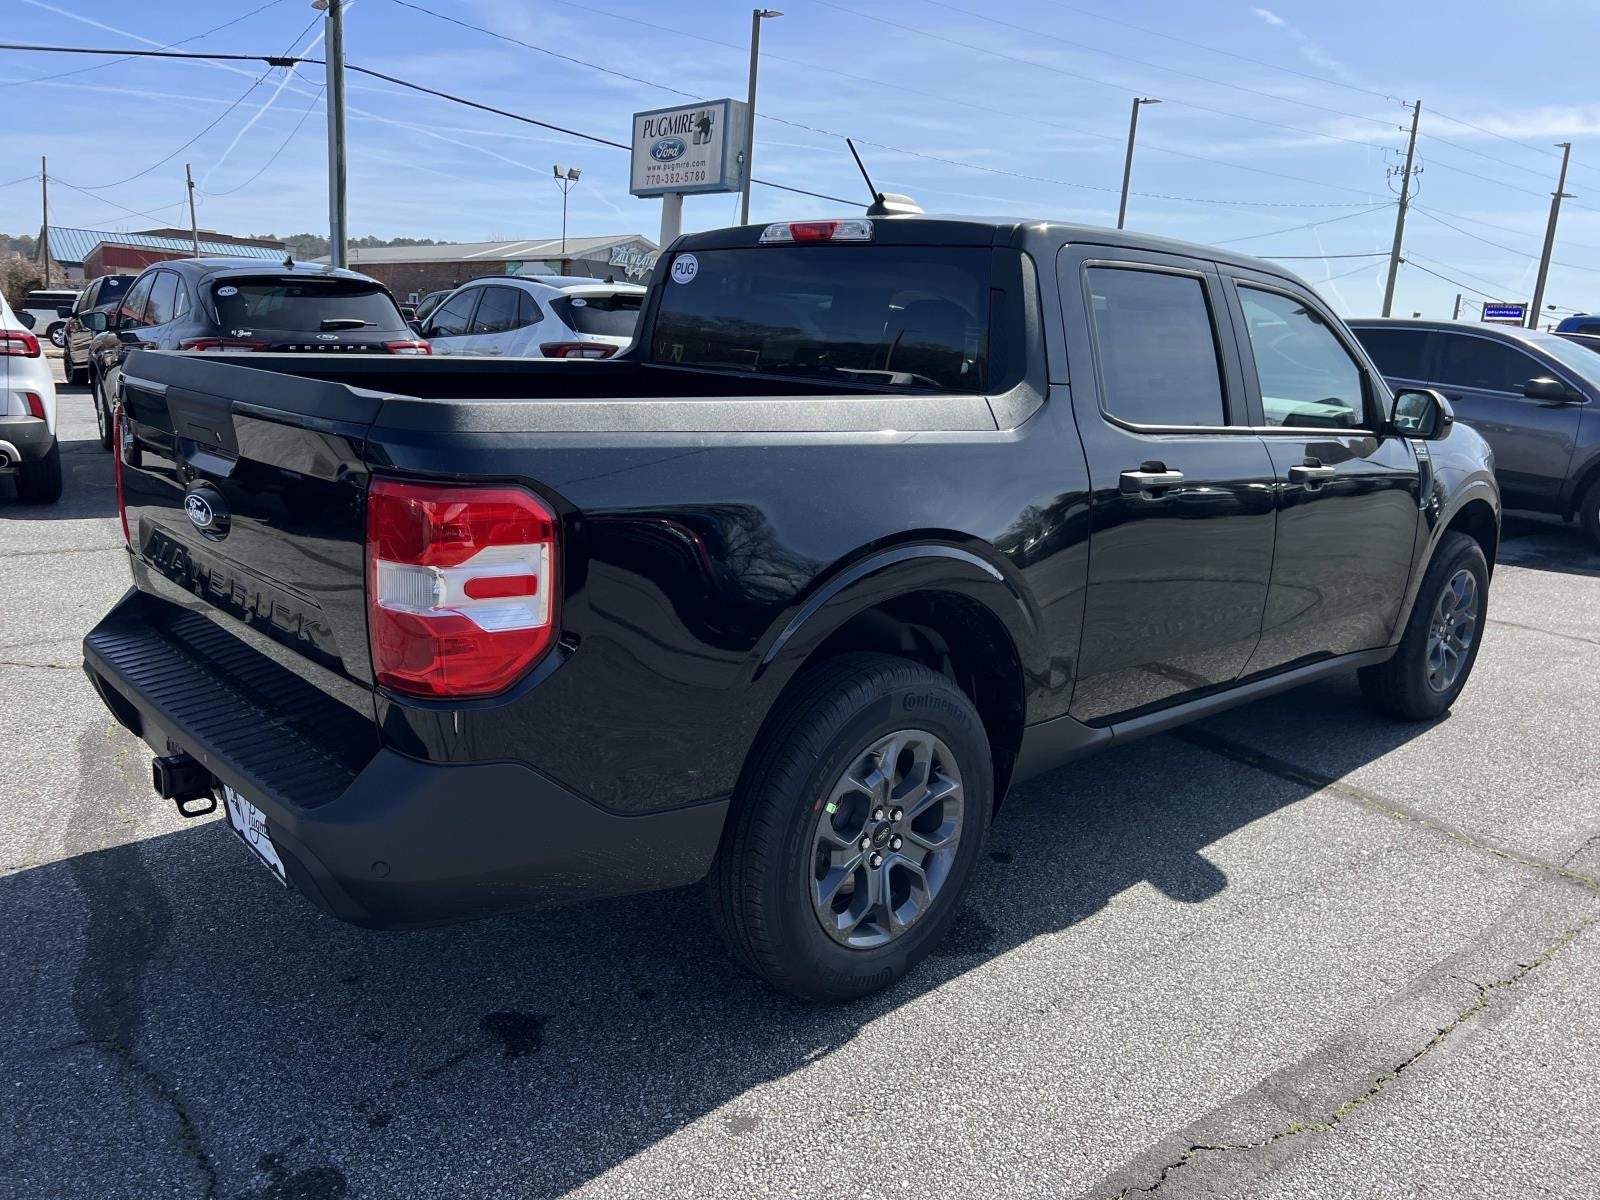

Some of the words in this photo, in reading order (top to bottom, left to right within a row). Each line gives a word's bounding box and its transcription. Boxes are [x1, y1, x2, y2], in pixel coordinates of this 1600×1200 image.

[642, 112, 696, 139] PUGMIRE
[654, 140, 681, 159] Ford
[647, 160, 706, 172] www.pugmire.com
[646, 170, 706, 185] 770-382-5780
[674, 262, 695, 275] PUG
[187, 497, 207, 522] Ford
